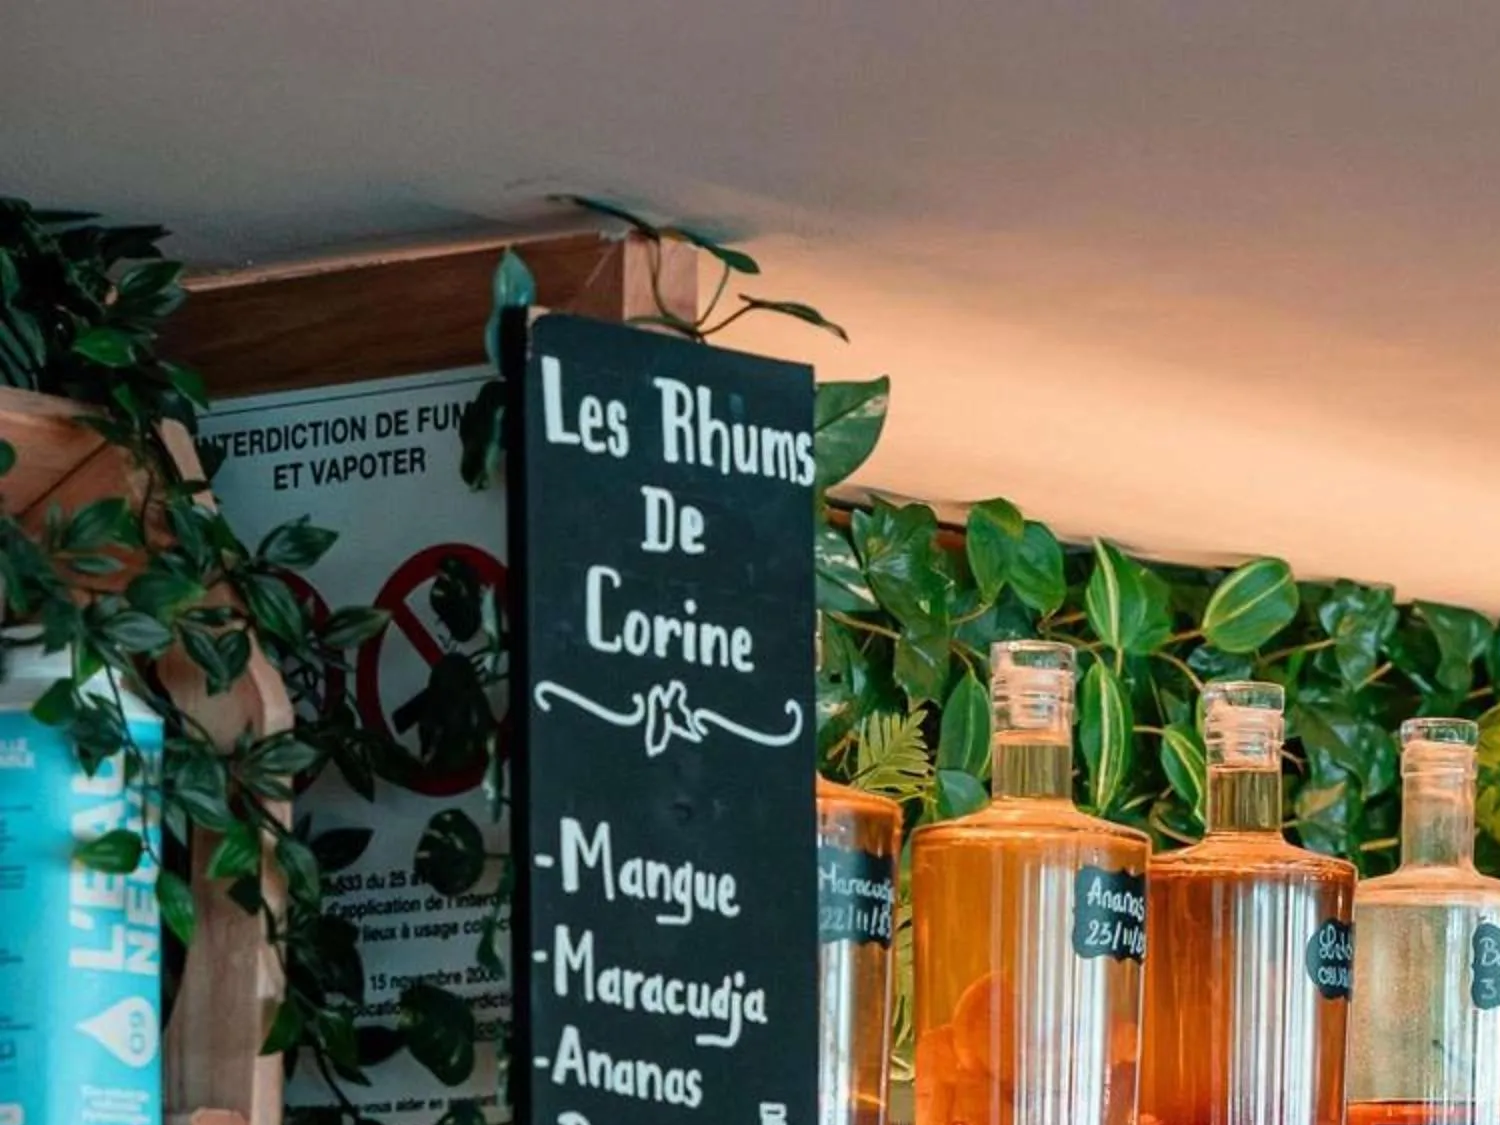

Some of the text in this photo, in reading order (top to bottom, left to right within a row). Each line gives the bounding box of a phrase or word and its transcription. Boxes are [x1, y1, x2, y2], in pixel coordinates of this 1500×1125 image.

[376, 409, 408, 439] DE
[541, 356, 817, 487] Les Rhums
[273, 447, 427, 491] ET VAPOTER
[641, 485, 706, 554] De
[585, 564, 755, 673] Corine
[413, 922, 459, 941] usage
[370, 974, 386, 990] 15
